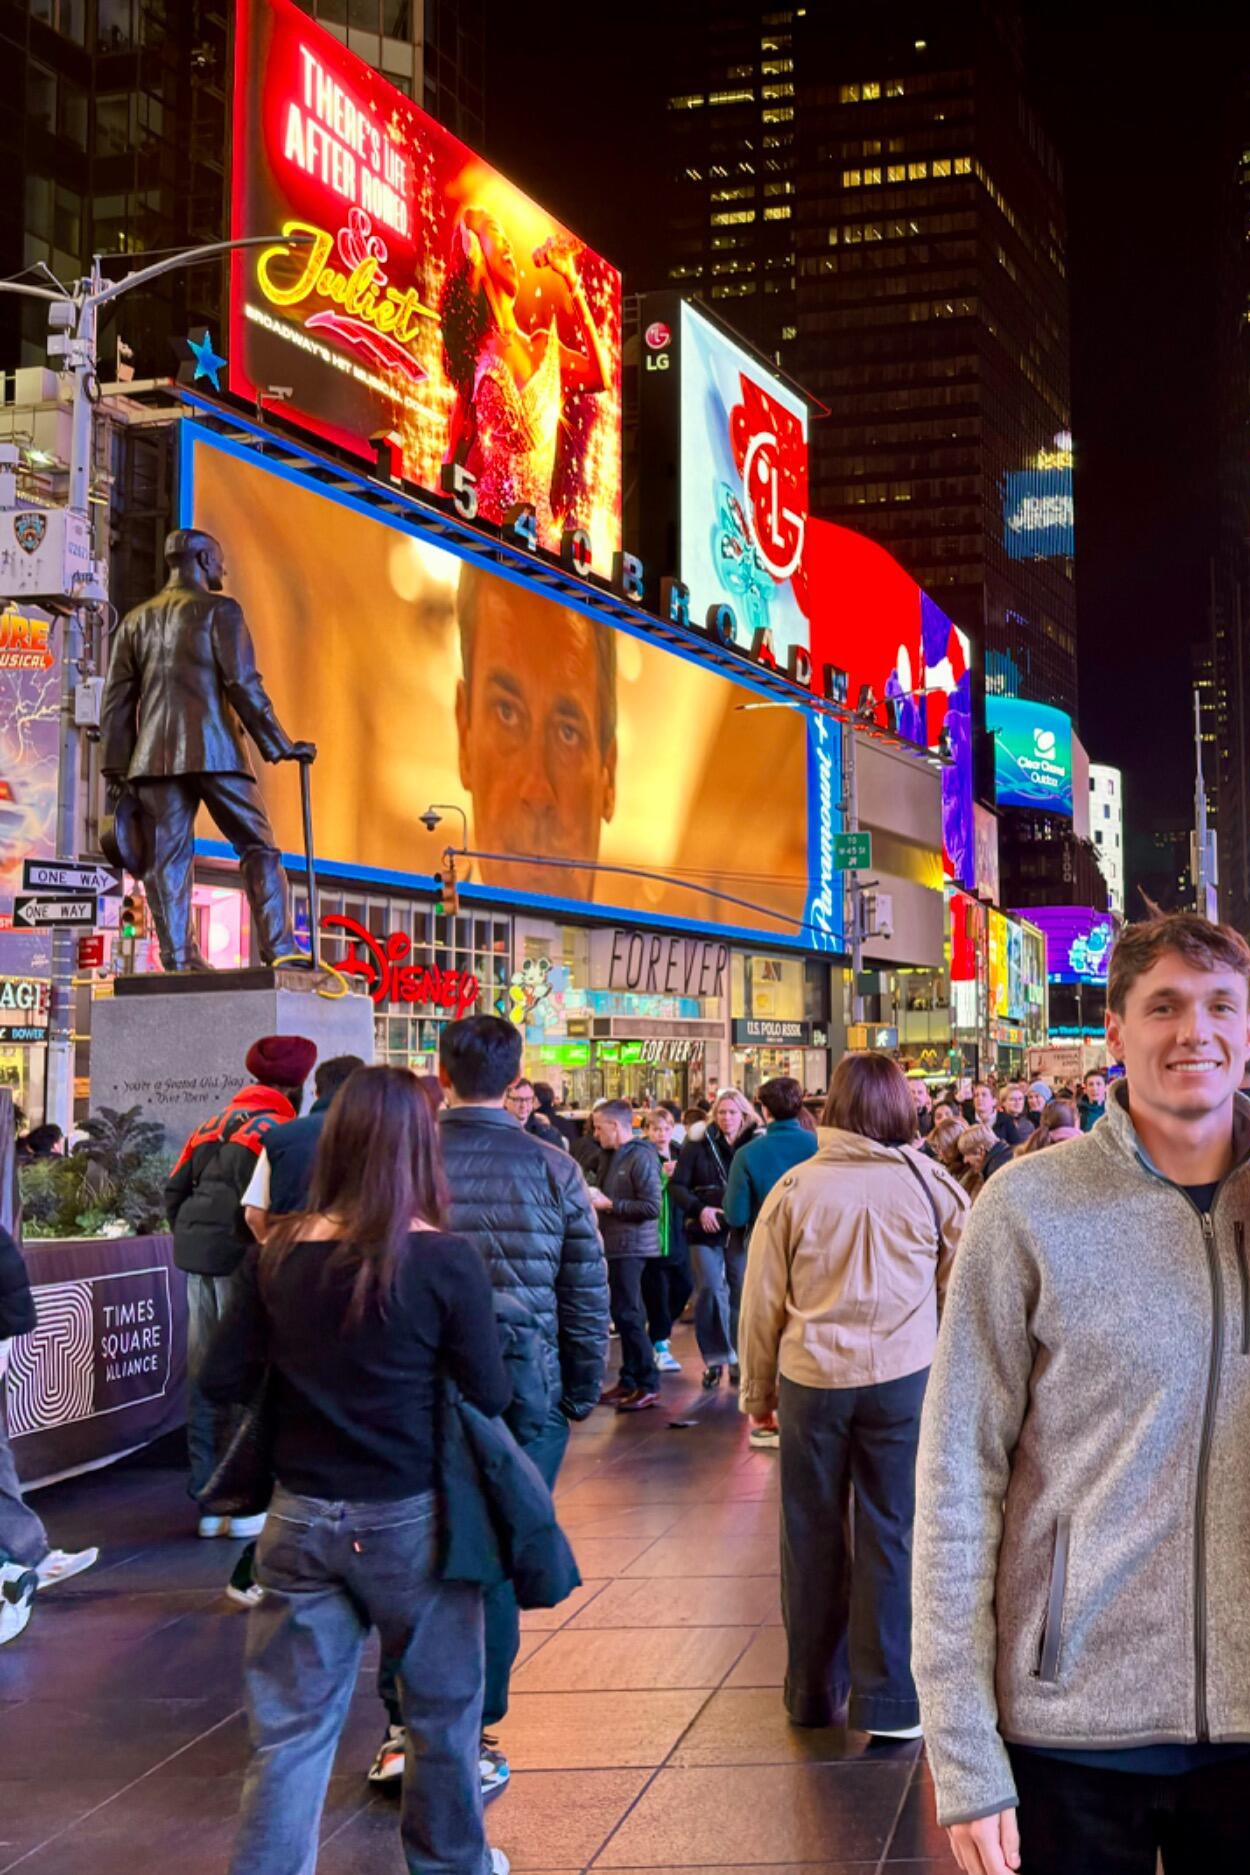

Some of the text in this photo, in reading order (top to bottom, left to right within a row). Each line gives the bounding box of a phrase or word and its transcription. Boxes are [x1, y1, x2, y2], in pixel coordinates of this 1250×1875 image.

[299, 43, 407, 197] THERE'S LIFE
[284, 102, 357, 202] AFTER
[257, 221, 442, 342] Juliet
[646, 355, 670, 371] LG
[38, 870, 109, 887] ONE WAY
[25, 904, 87, 919] ONE WAY
[609, 930, 729, 997] FOREVER
[103, 1299, 155, 1329] TIMES
[101, 1325, 161, 1359] SQUARE
[106, 1354, 158, 1383] ALLIANCE
